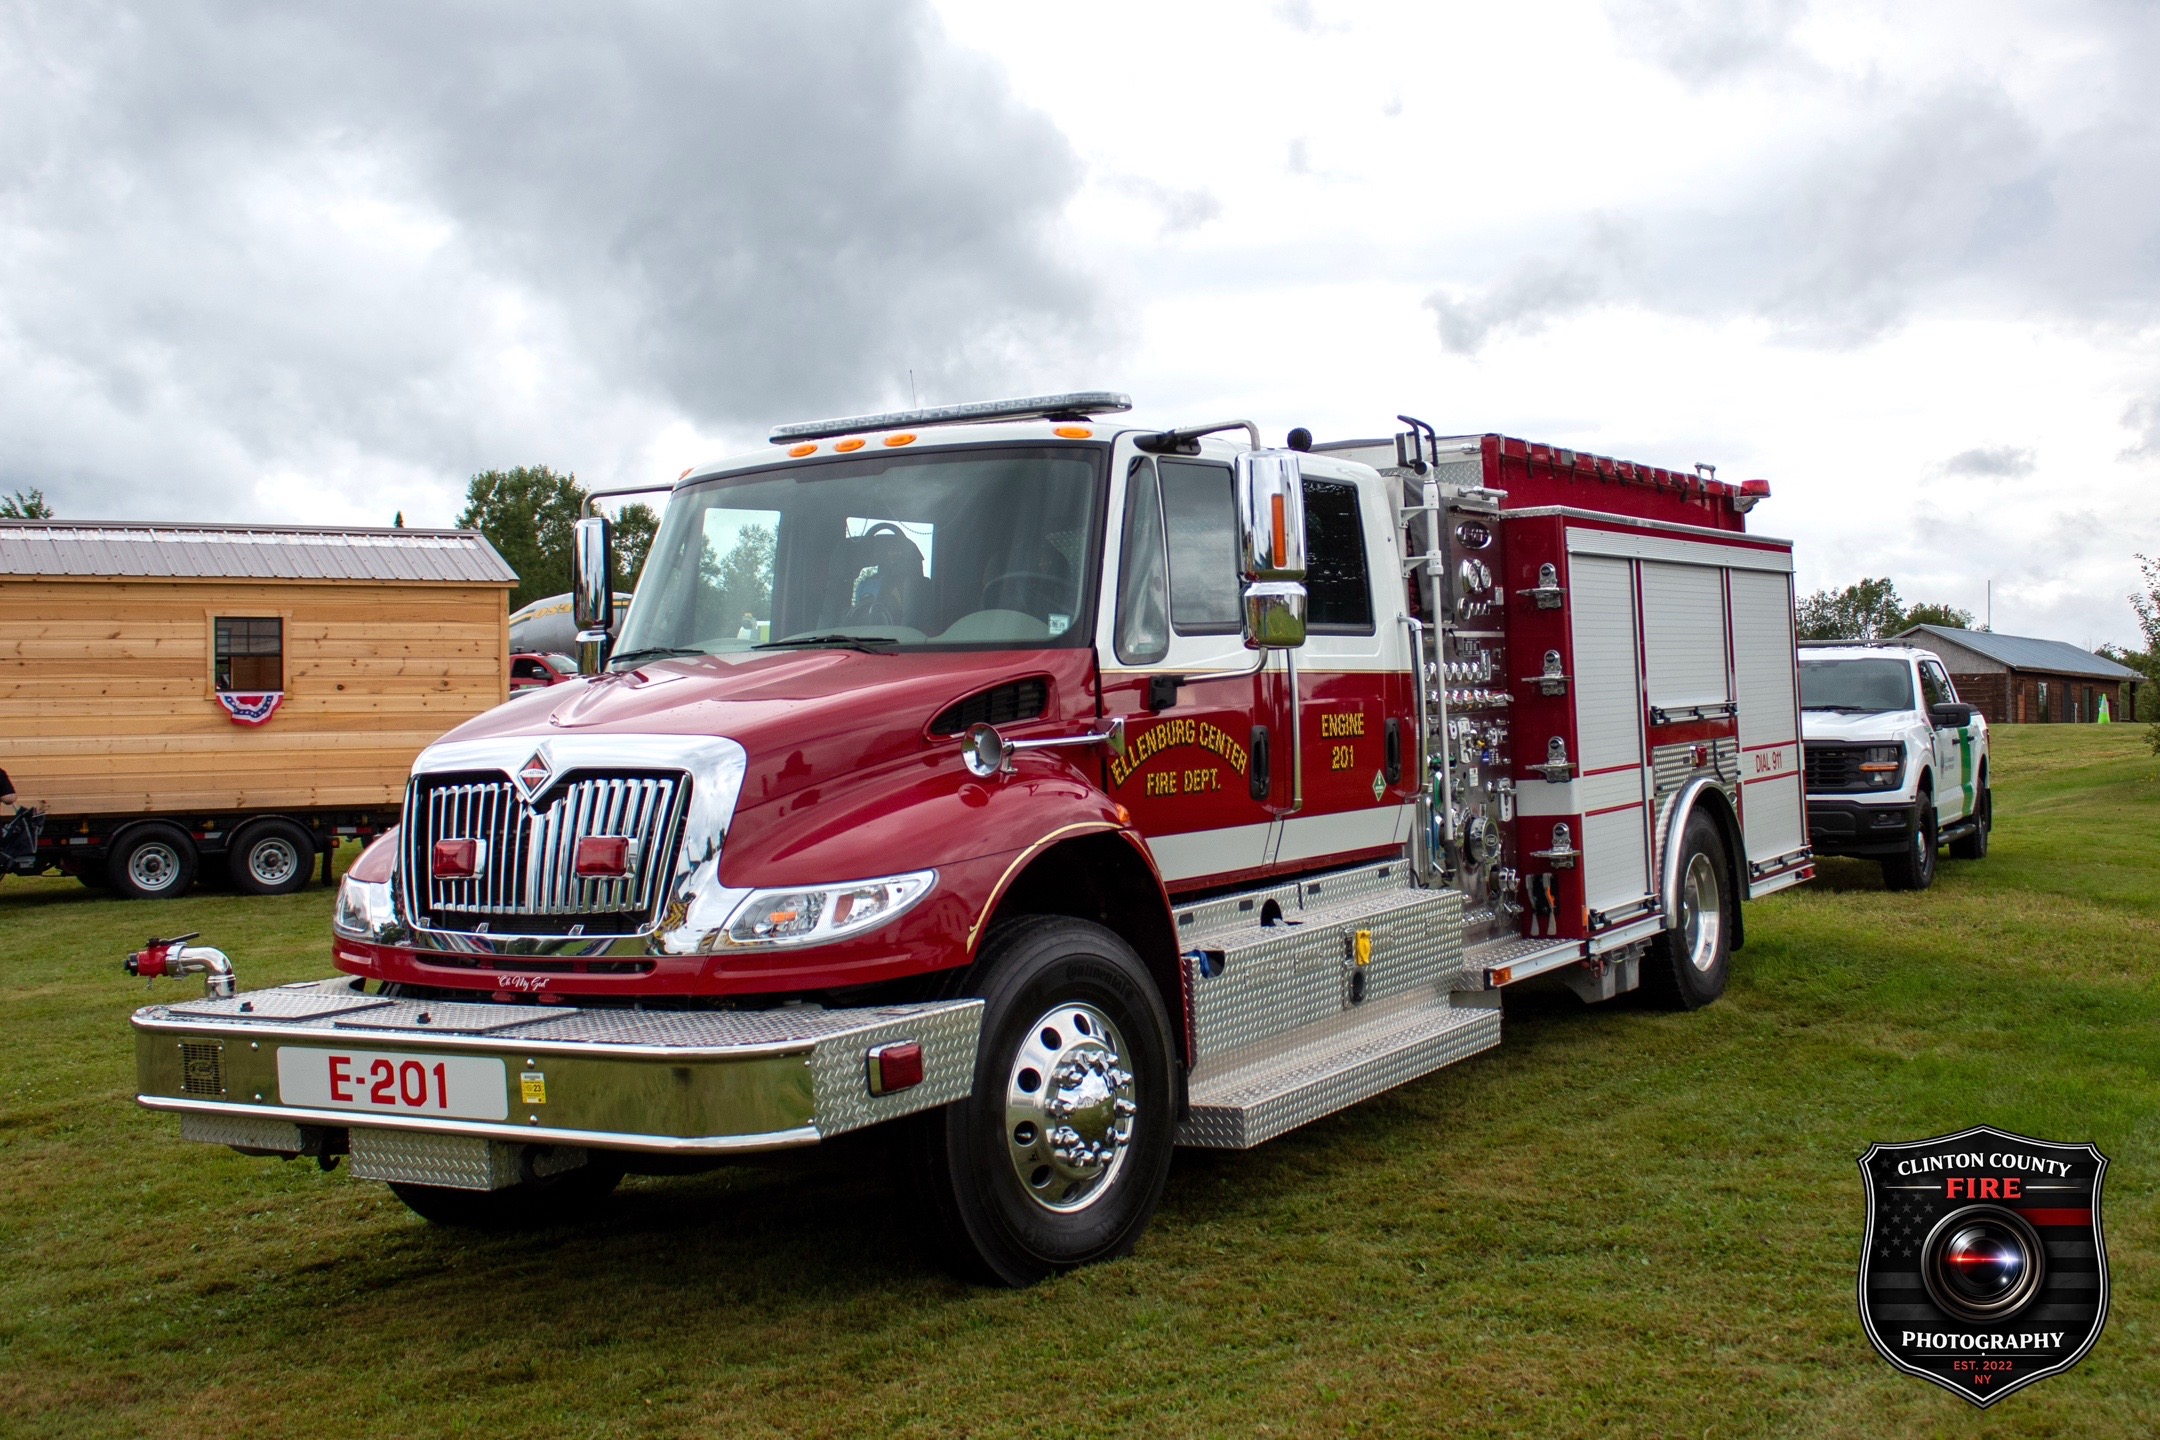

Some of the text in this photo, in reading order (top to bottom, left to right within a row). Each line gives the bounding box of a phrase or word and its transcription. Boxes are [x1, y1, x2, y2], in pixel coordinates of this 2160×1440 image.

[1321, 712, 1365, 738] ENGINE
[1110, 718, 1248, 787] ELLENBURG CENTER
[1332, 744, 1354, 770] 201
[1756, 750, 1782, 773] DIAL 911
[1146, 767, 1221, 796] FIRE DEPT.
[328, 1055, 448, 1109] E-201
